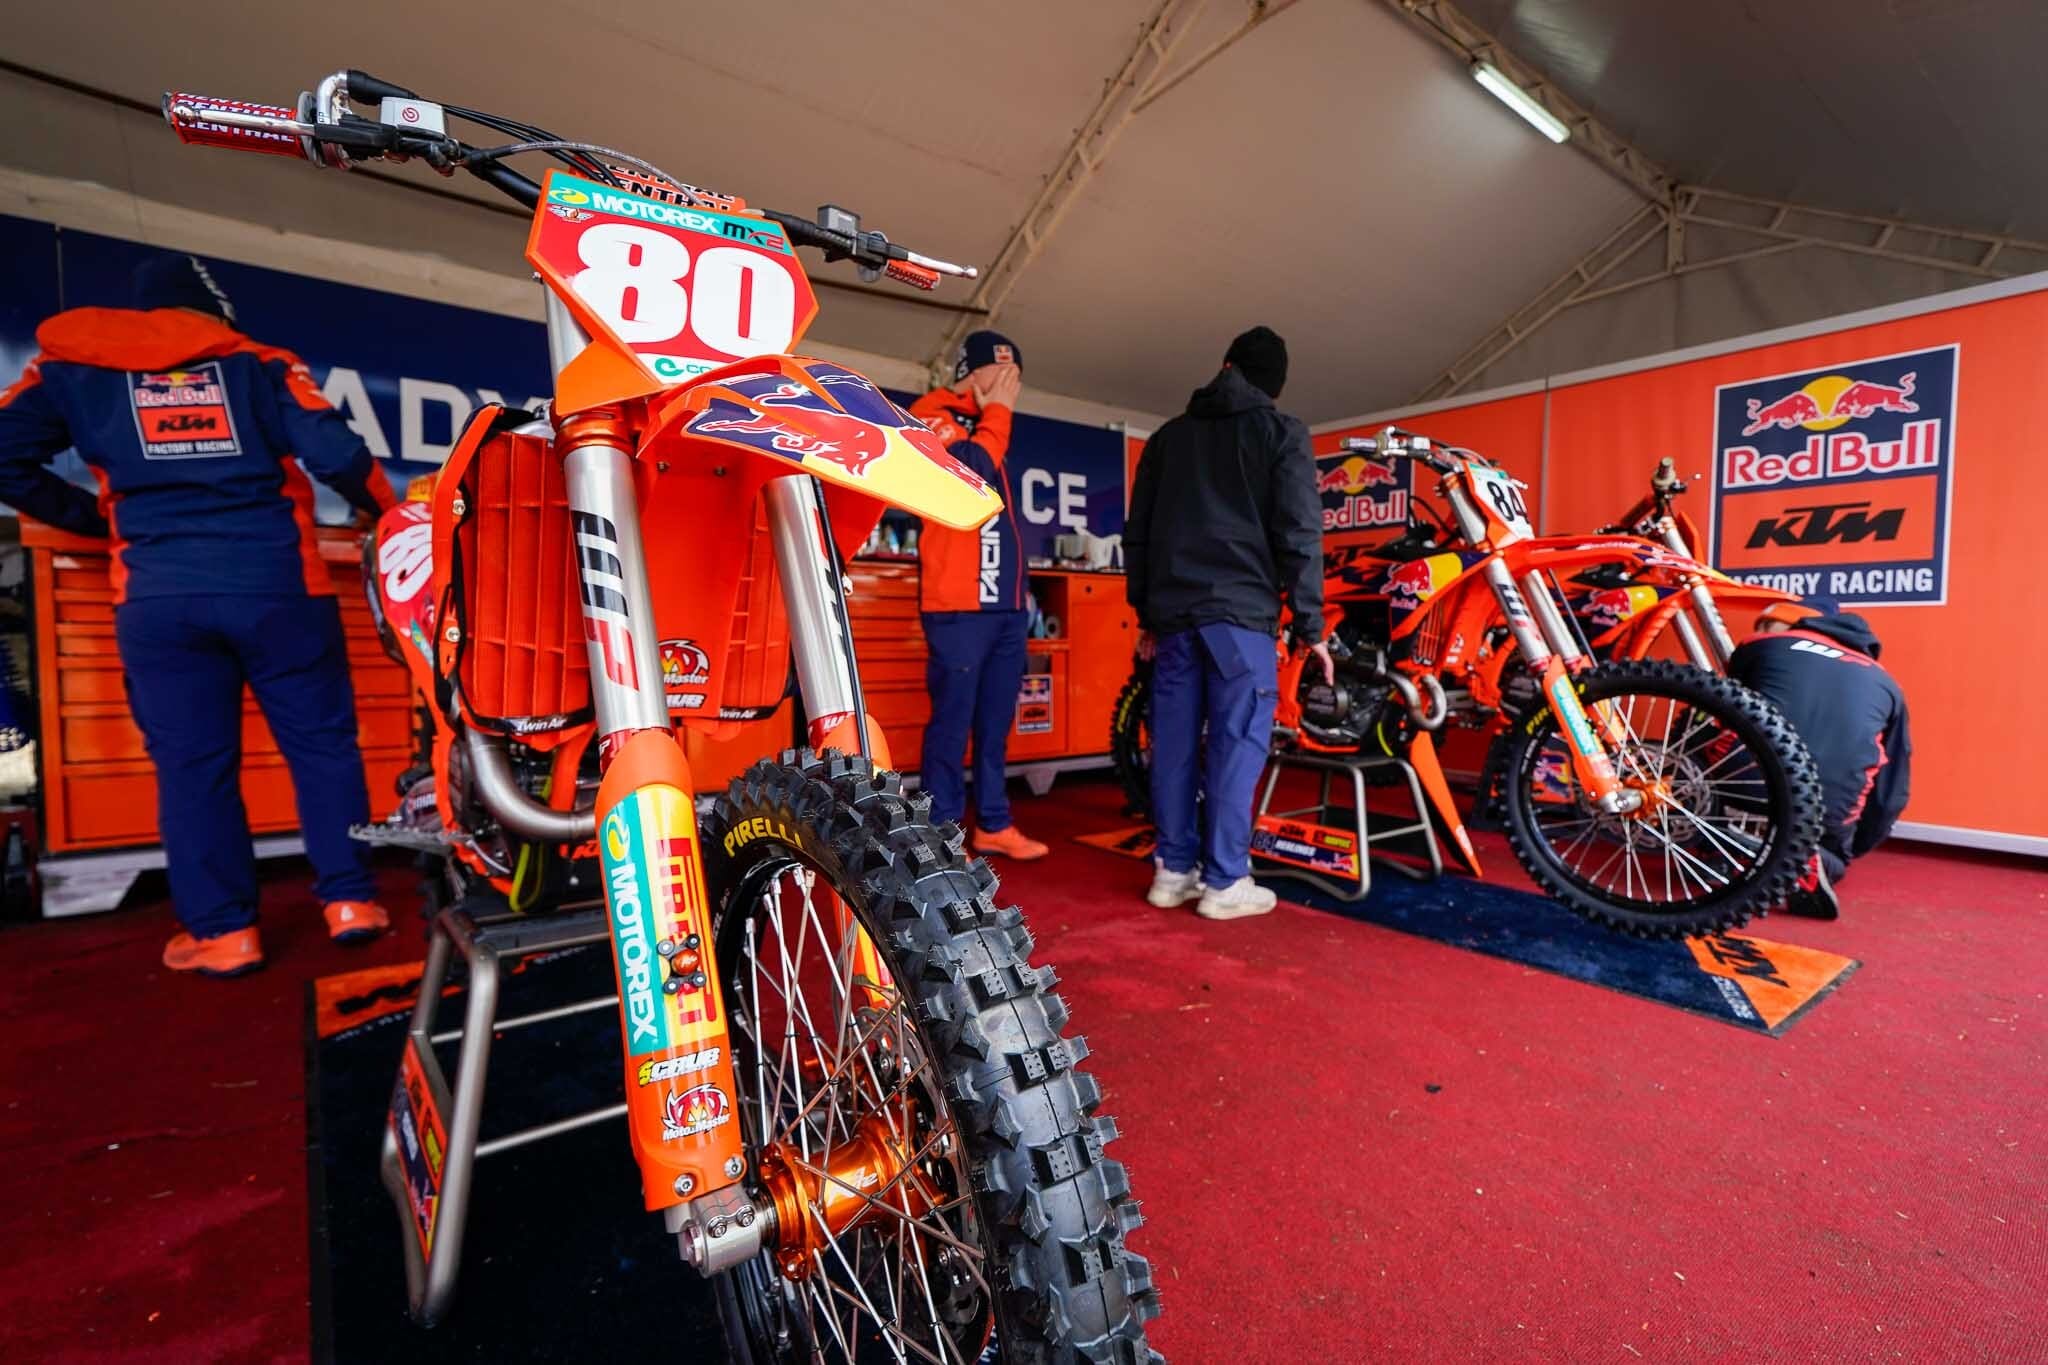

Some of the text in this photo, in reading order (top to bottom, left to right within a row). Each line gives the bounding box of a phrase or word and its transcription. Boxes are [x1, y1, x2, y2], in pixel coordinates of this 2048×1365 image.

[591, 191, 721, 234] MOTOREX
[569, 223, 795, 360] 80
[134, 384, 223, 407] Red Bull
[157, 414, 216, 432] KTM
[1725, 420, 1940, 487] Red Bull
[1321, 490, 1408, 529] ed Bull
[1745, 502, 1905, 550] KTM
[1830, 567, 1934, 595] RACING
[516, 716, 568, 732] Twin Air
[723, 817, 805, 858] PIRELLI
[611, 862, 659, 1044] MOTOREX
